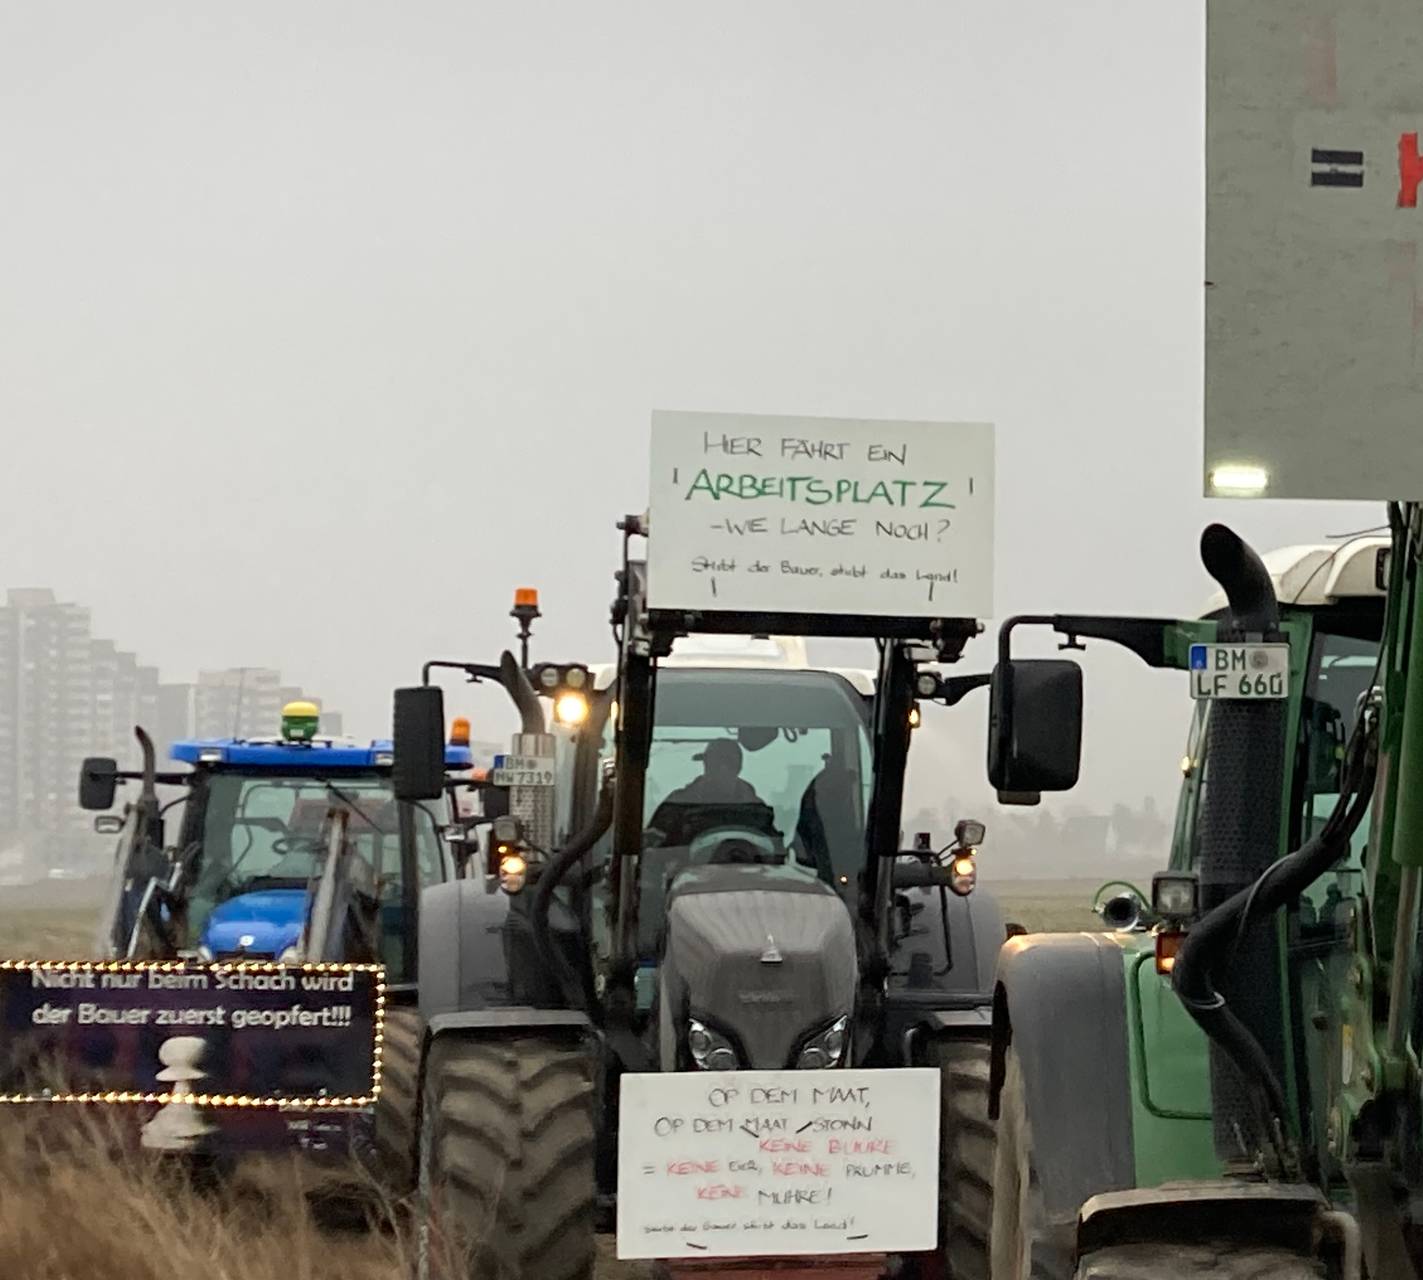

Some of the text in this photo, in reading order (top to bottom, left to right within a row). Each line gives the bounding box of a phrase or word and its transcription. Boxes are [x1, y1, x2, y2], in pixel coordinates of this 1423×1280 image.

[867, 444, 907, 465] EIN
[685, 467, 956, 509] ARBEITSPLATZ
[780, 518, 858, 537] LANGE
[1215, 649, 1247, 671] BM
[1197, 673, 1283, 696] LF 660
[101, 974, 143, 989] nur
[148, 968, 209, 989] beim
[215, 970, 295, 991] Schach
[301, 971, 354, 992] wird
[32, 1003, 351, 1030] der Bauer zuerst geopfert!!!
[751, 1087, 798, 1104] DEM
[654, 1117, 685, 1137] OP
[693, 1118, 734, 1133] DEM
